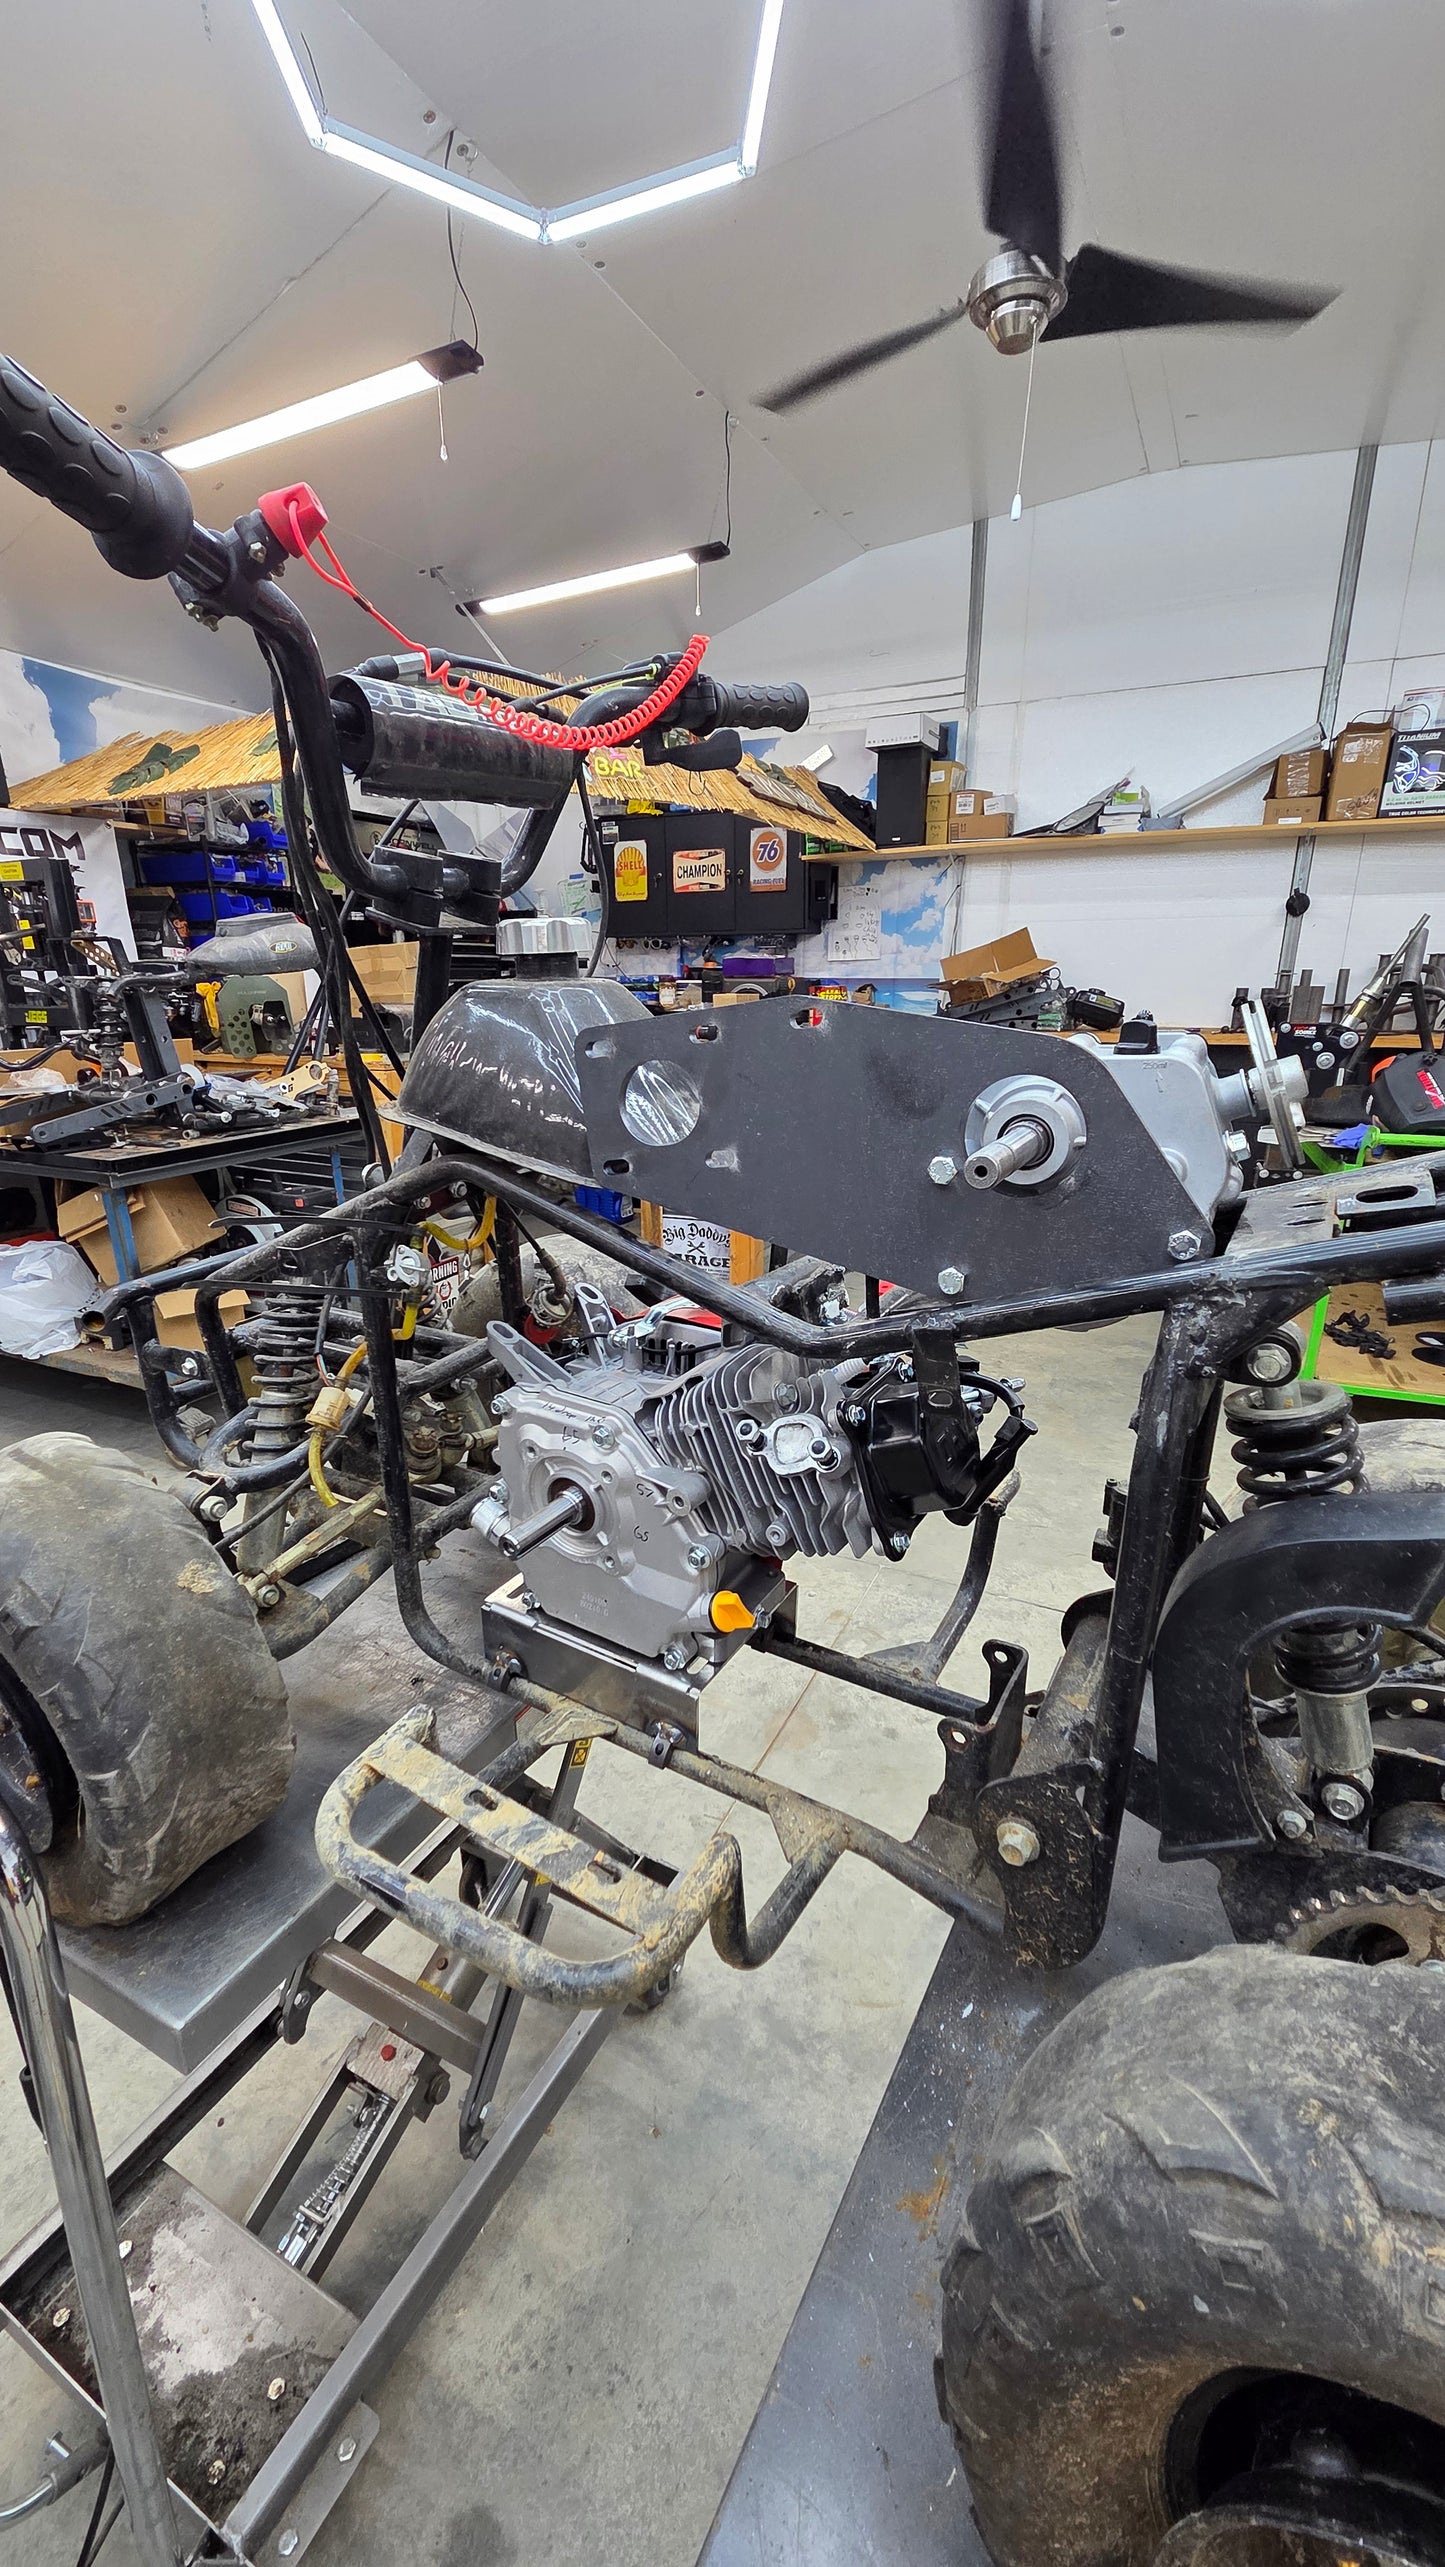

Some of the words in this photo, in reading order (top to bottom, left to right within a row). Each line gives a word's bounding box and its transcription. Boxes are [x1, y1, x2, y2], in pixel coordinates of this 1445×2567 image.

[594, 757, 645, 778] BAR
[757, 839, 780, 862] 76
[619, 860, 643, 872] SHELL
[677, 863, 722, 879] CHAMPION
[25, 1010, 47, 1023] JEGS
[663, 1225, 686, 1245] Big
[687, 1222, 730, 1248] Daddy's
